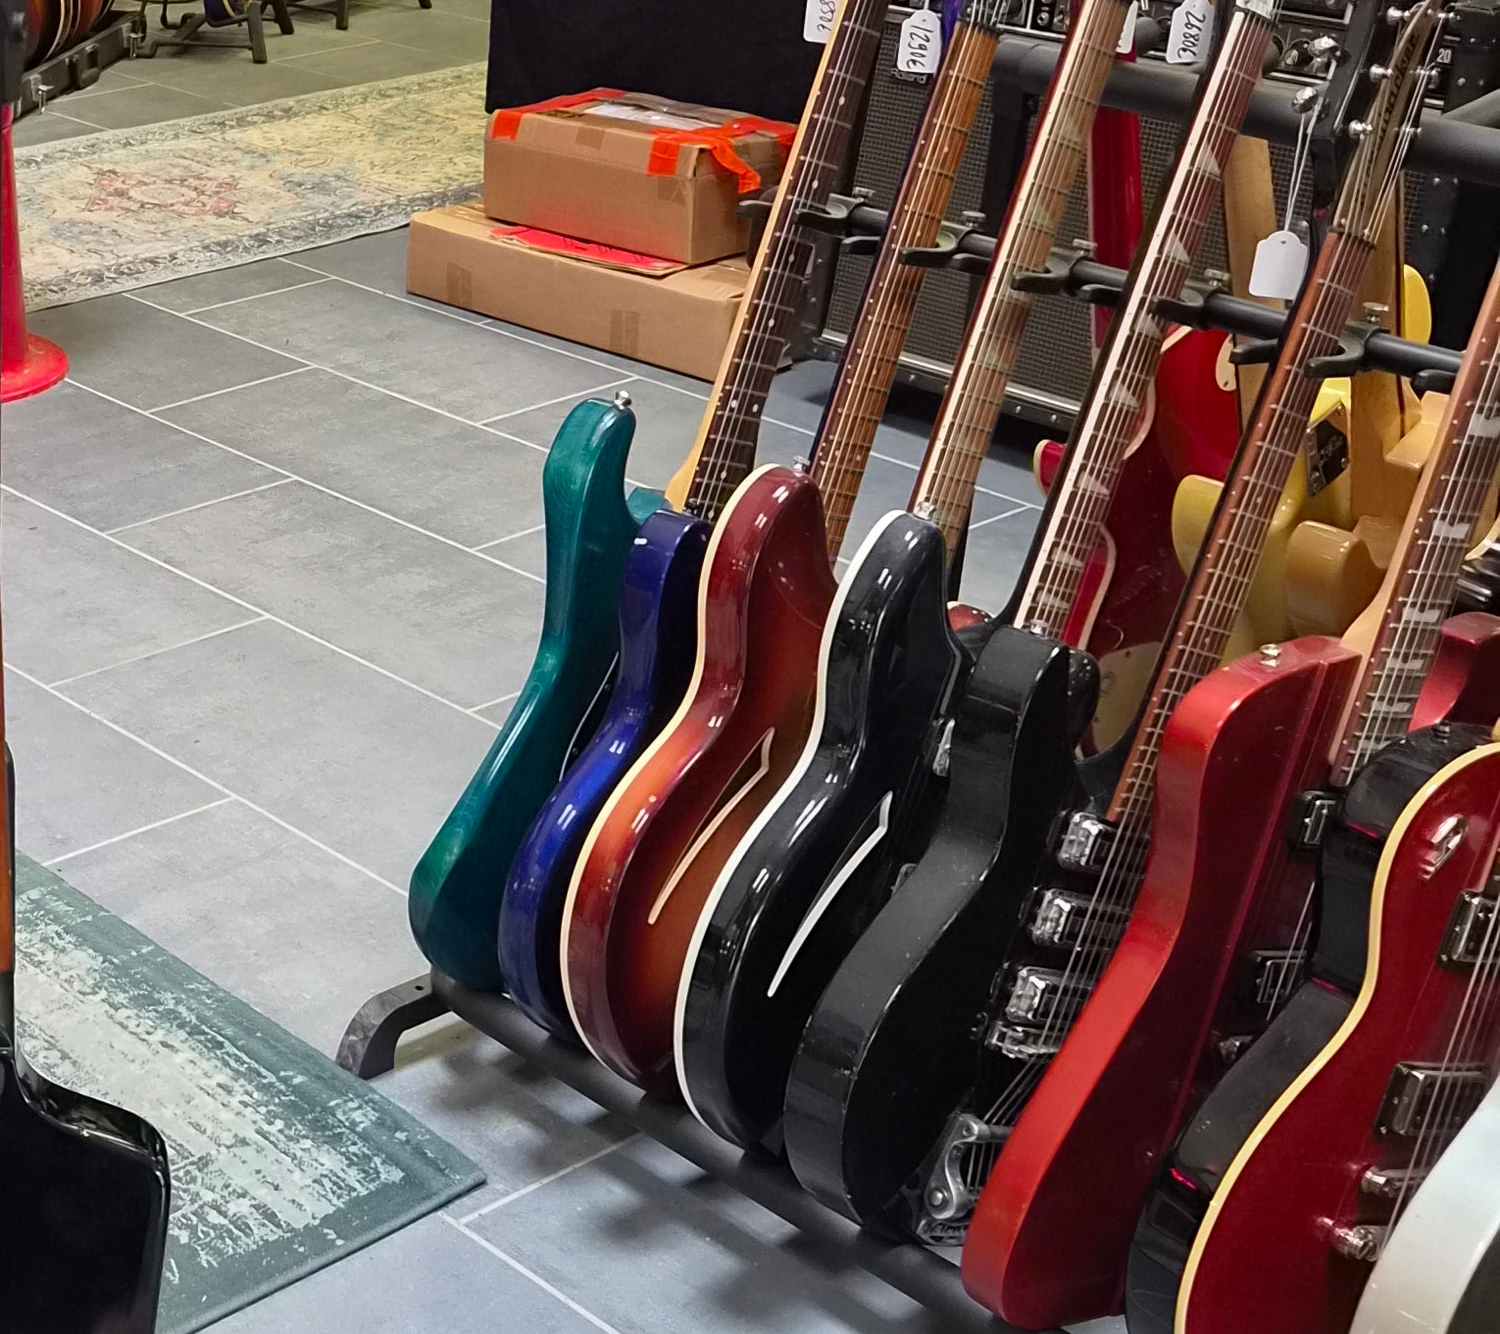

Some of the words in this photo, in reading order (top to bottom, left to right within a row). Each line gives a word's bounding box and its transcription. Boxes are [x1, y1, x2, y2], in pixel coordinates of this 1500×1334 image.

[906, 25, 933, 71] 1290€
[1177, 10, 1206, 59] 2680€
[1436, 48, 1451, 64] 20
